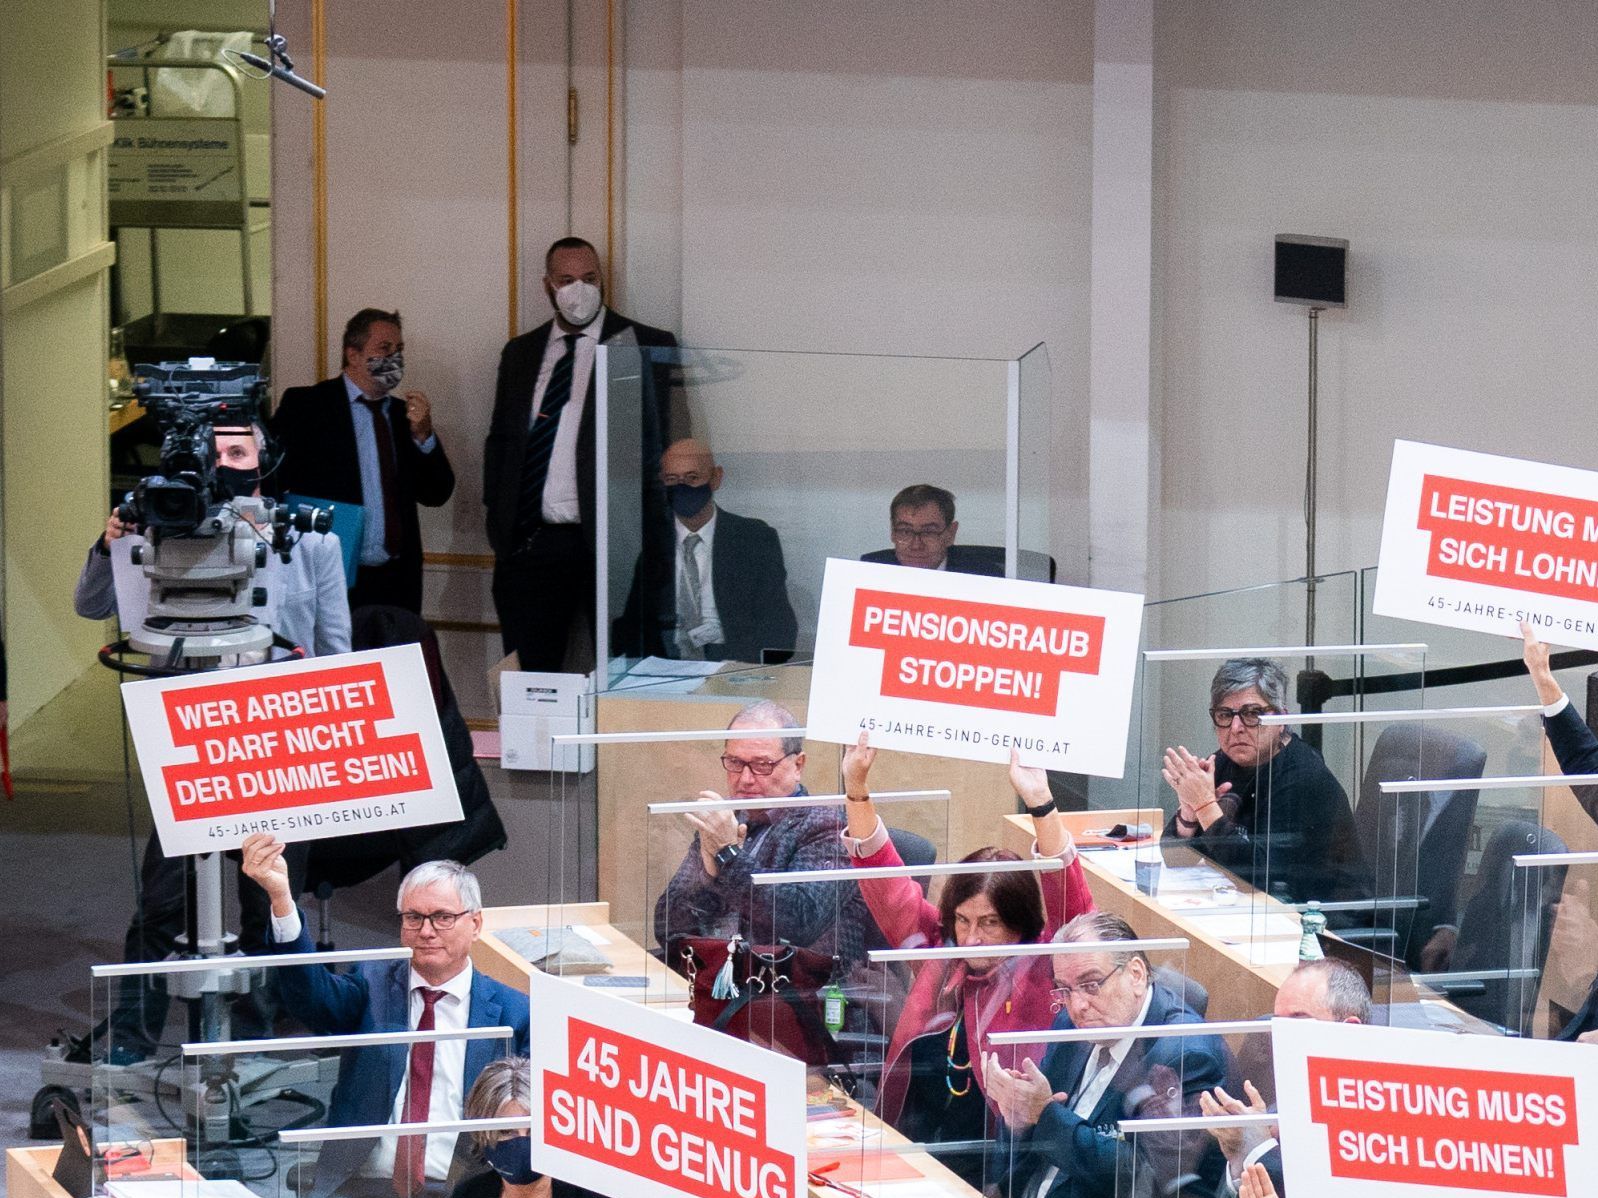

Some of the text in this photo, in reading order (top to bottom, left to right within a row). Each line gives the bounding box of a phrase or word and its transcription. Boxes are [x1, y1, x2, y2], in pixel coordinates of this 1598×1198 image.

[1430, 491, 1575, 539] LEISTUNG
[1438, 537, 1509, 573] SICH
[863, 605, 1090, 658] PENSIONSRAUB
[898, 656, 1043, 700] STOPPEN!
[175, 679, 376, 730] WER ARBEITET
[205, 719, 366, 765] DARF NICHT
[859, 717, 1071, 755] 45-JAHRE-SIND-GENUG.AT
[175, 752, 418, 805] DER DUMME SEIN!
[208, 802, 406, 838] 45-JAHRE-SIND-GENUG.AT
[577, 1037, 757, 1138] 45 JAHRE
[1319, 1076, 1567, 1127] LEISTUNG MUSS
[550, 1089, 641, 1157] SIND
[1338, 1129, 1555, 1179] SICH LOHNEN!
